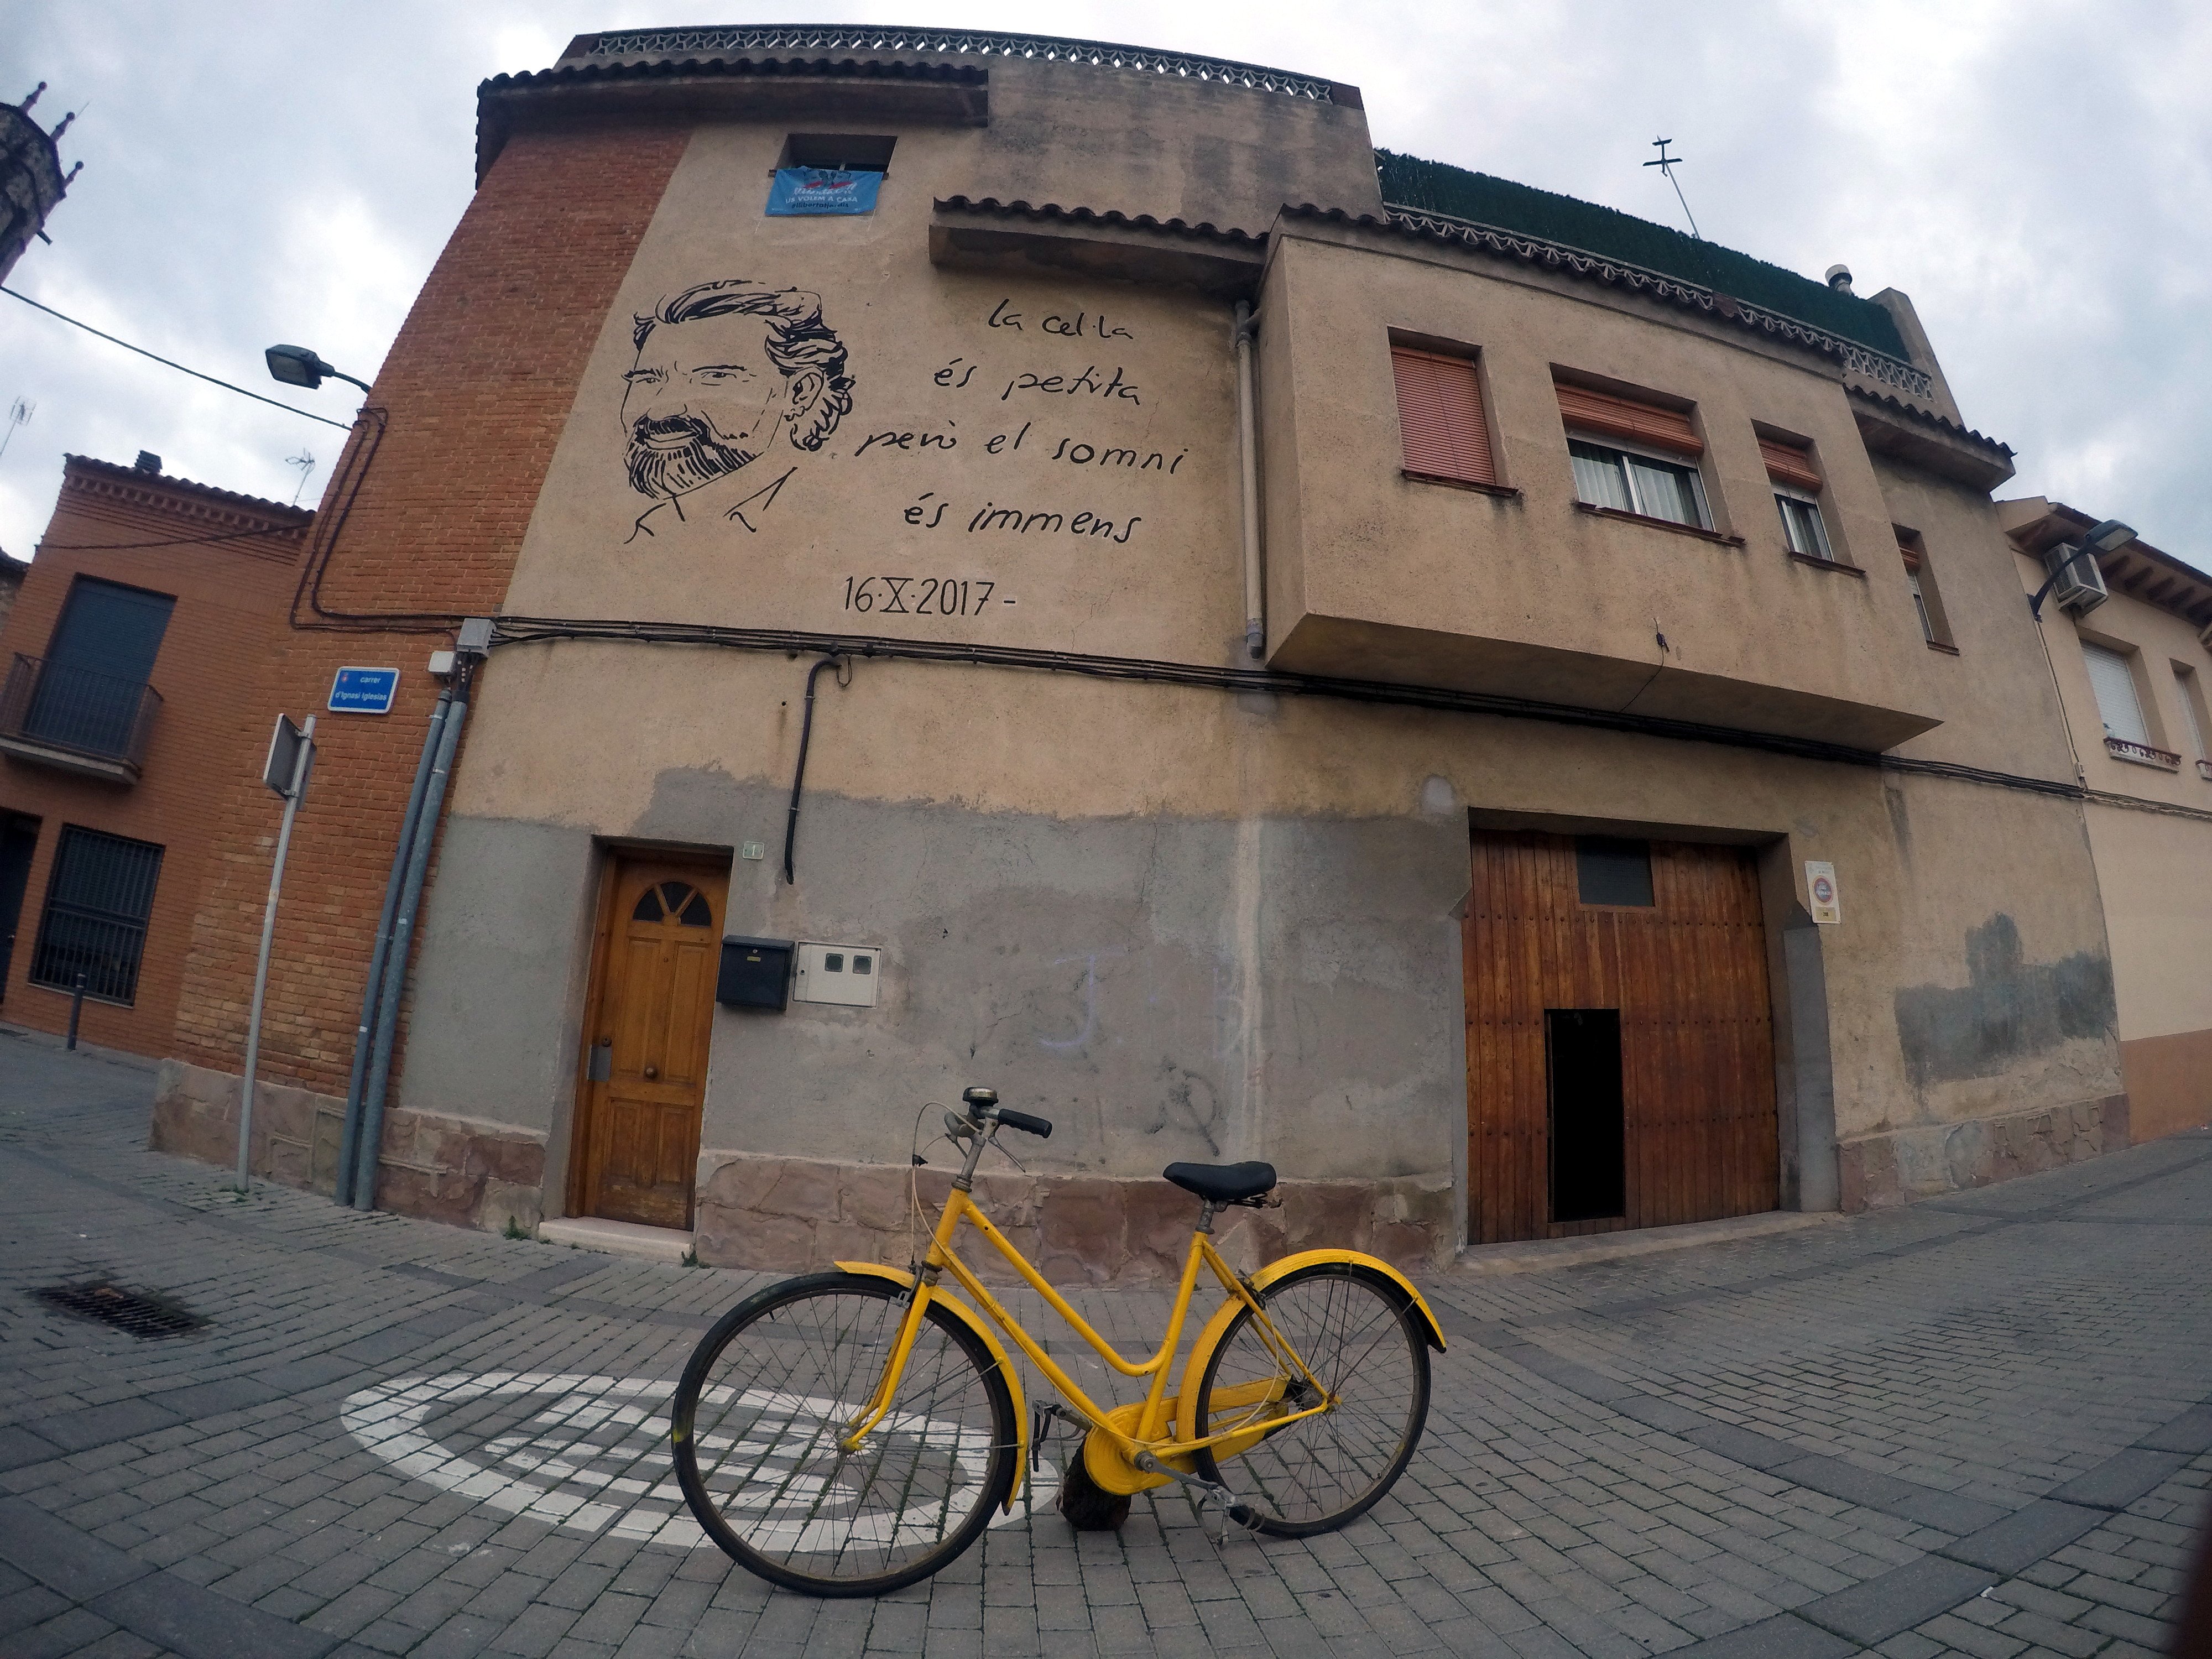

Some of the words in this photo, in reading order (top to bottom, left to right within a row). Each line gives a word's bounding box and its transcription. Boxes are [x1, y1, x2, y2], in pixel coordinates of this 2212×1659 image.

[933, 357, 977, 388] és
[1001, 366, 1140, 405] petita
[854, 420, 957, 457] però
[984, 422, 1031, 454] el
[1052, 438, 1188, 474] somni
[904, 492, 949, 528] és
[968, 502, 1141, 544] immens
[335, 691, 361, 700] d'Ignasi
[362, 692, 387, 701] Iglesias
